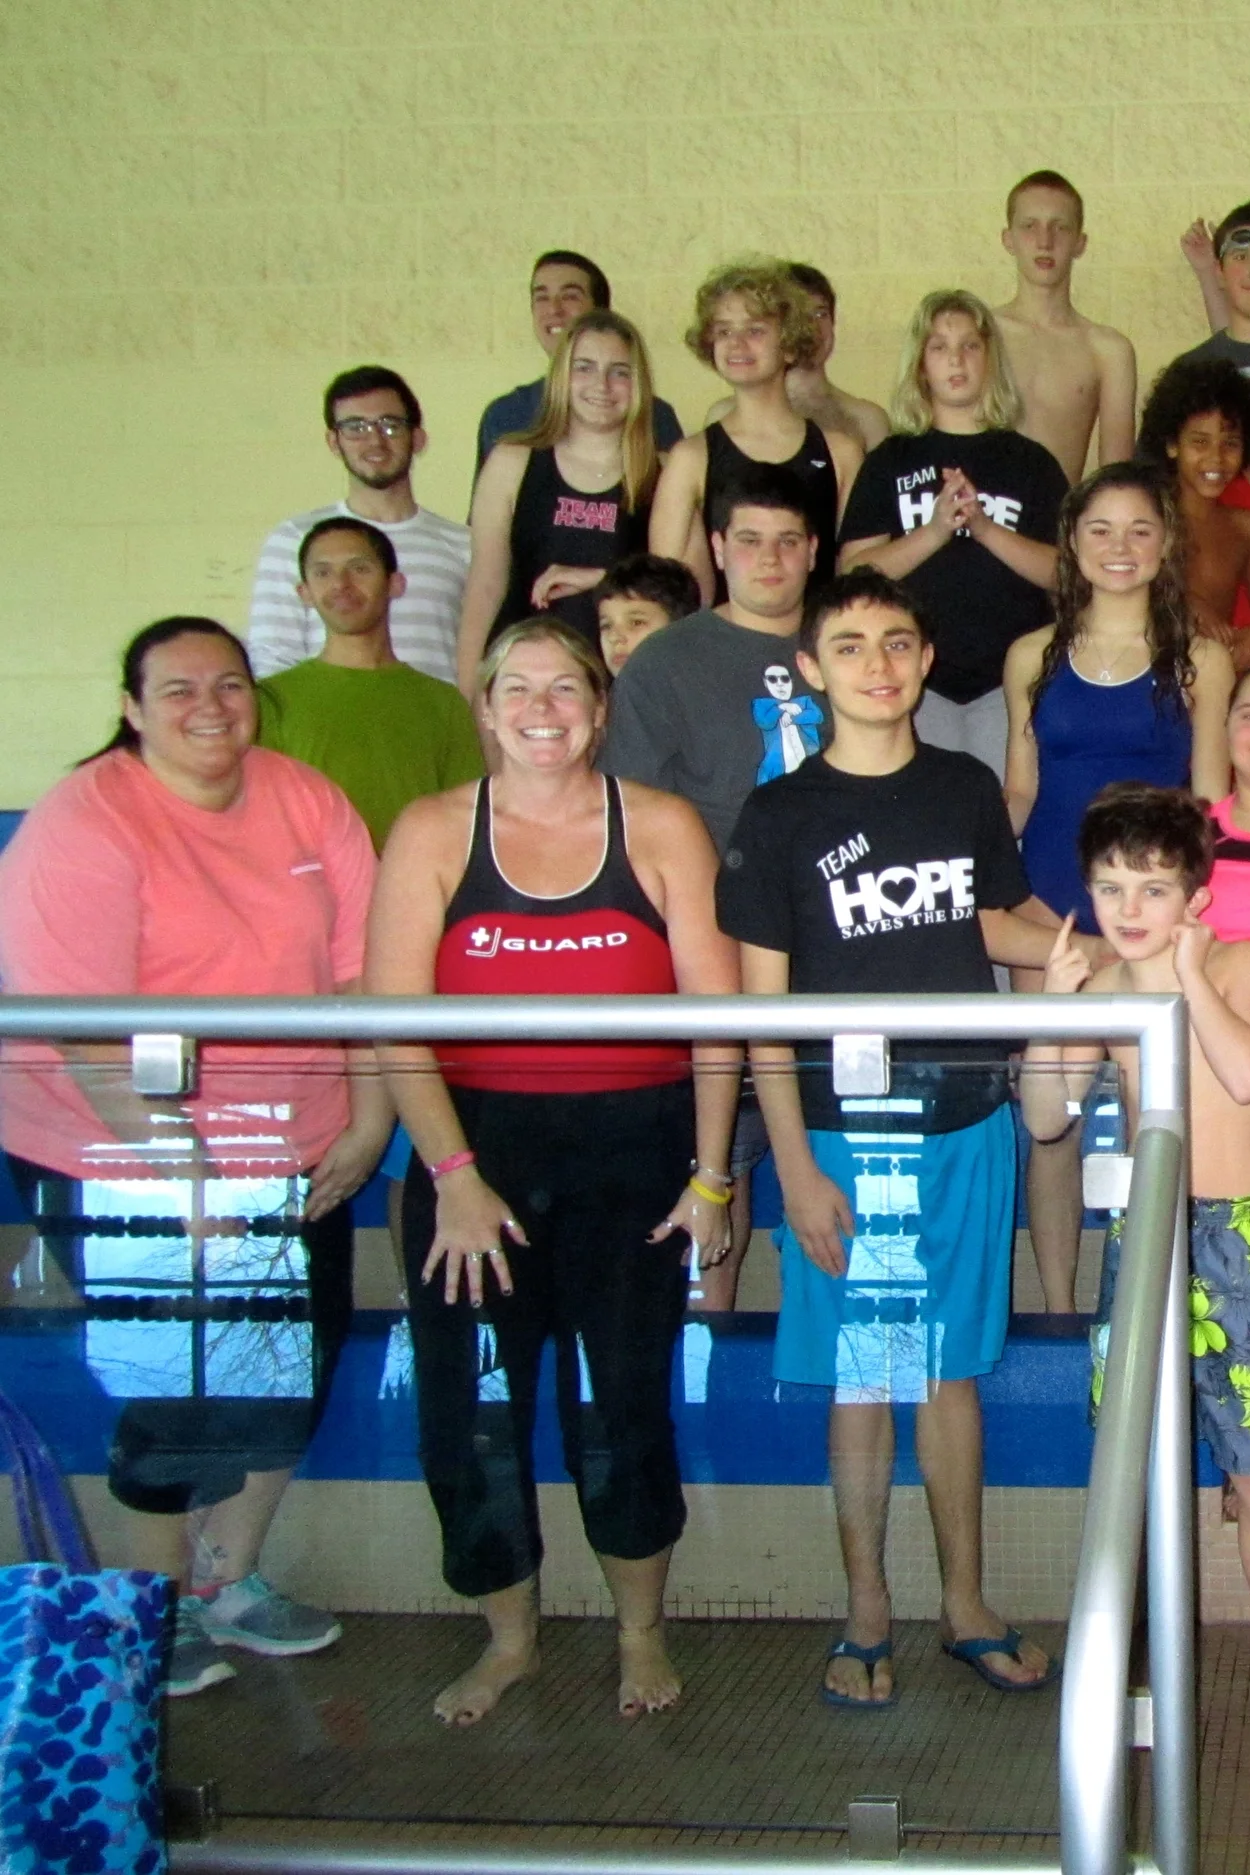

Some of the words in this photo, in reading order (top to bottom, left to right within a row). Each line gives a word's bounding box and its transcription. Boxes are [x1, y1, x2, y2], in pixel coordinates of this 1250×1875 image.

[557, 496, 617, 515] TEAM
[553, 510, 616, 533] HOPE
[816, 832, 871, 881] TEAM
[829, 857, 975, 929] HOPE
[841, 917, 904, 940] SAVES
[908, 909, 947, 926] THE
[951, 906, 975, 921] DA
[502, 932, 628, 951] GUARD
